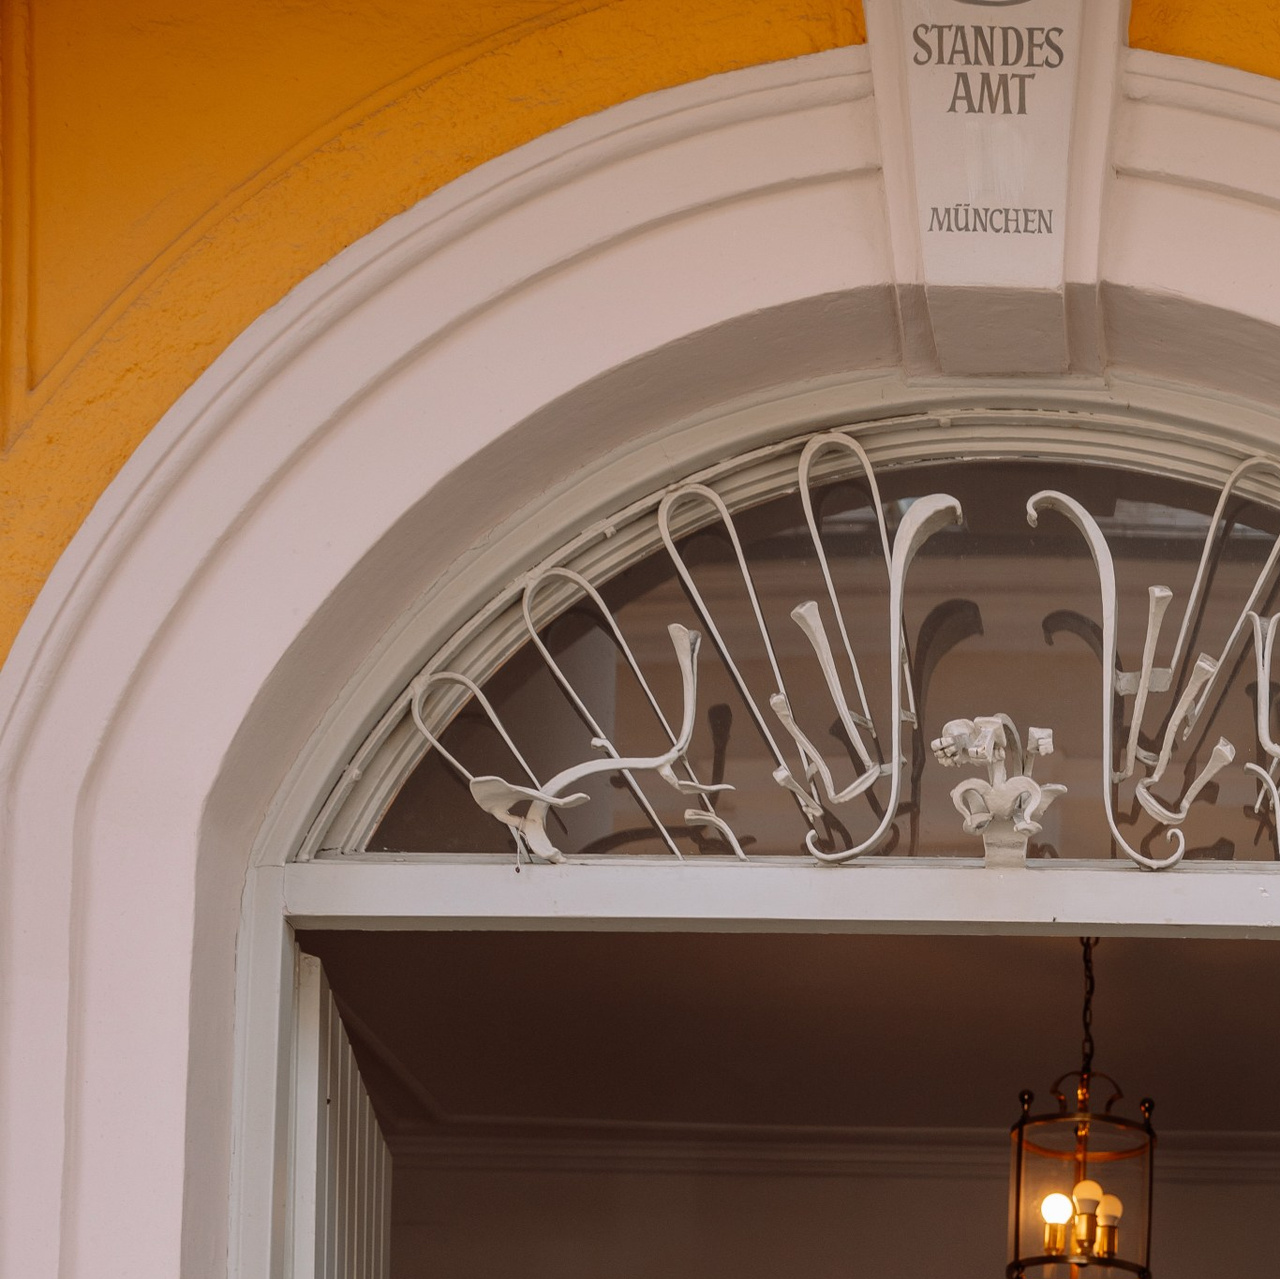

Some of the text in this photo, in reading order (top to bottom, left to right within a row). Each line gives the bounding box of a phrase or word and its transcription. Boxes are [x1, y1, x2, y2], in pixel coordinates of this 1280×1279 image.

[912, 23, 1065, 69] STANDES
[946, 72, 1036, 116] AMT
[927, 203, 1054, 235] MÜNCHEN
